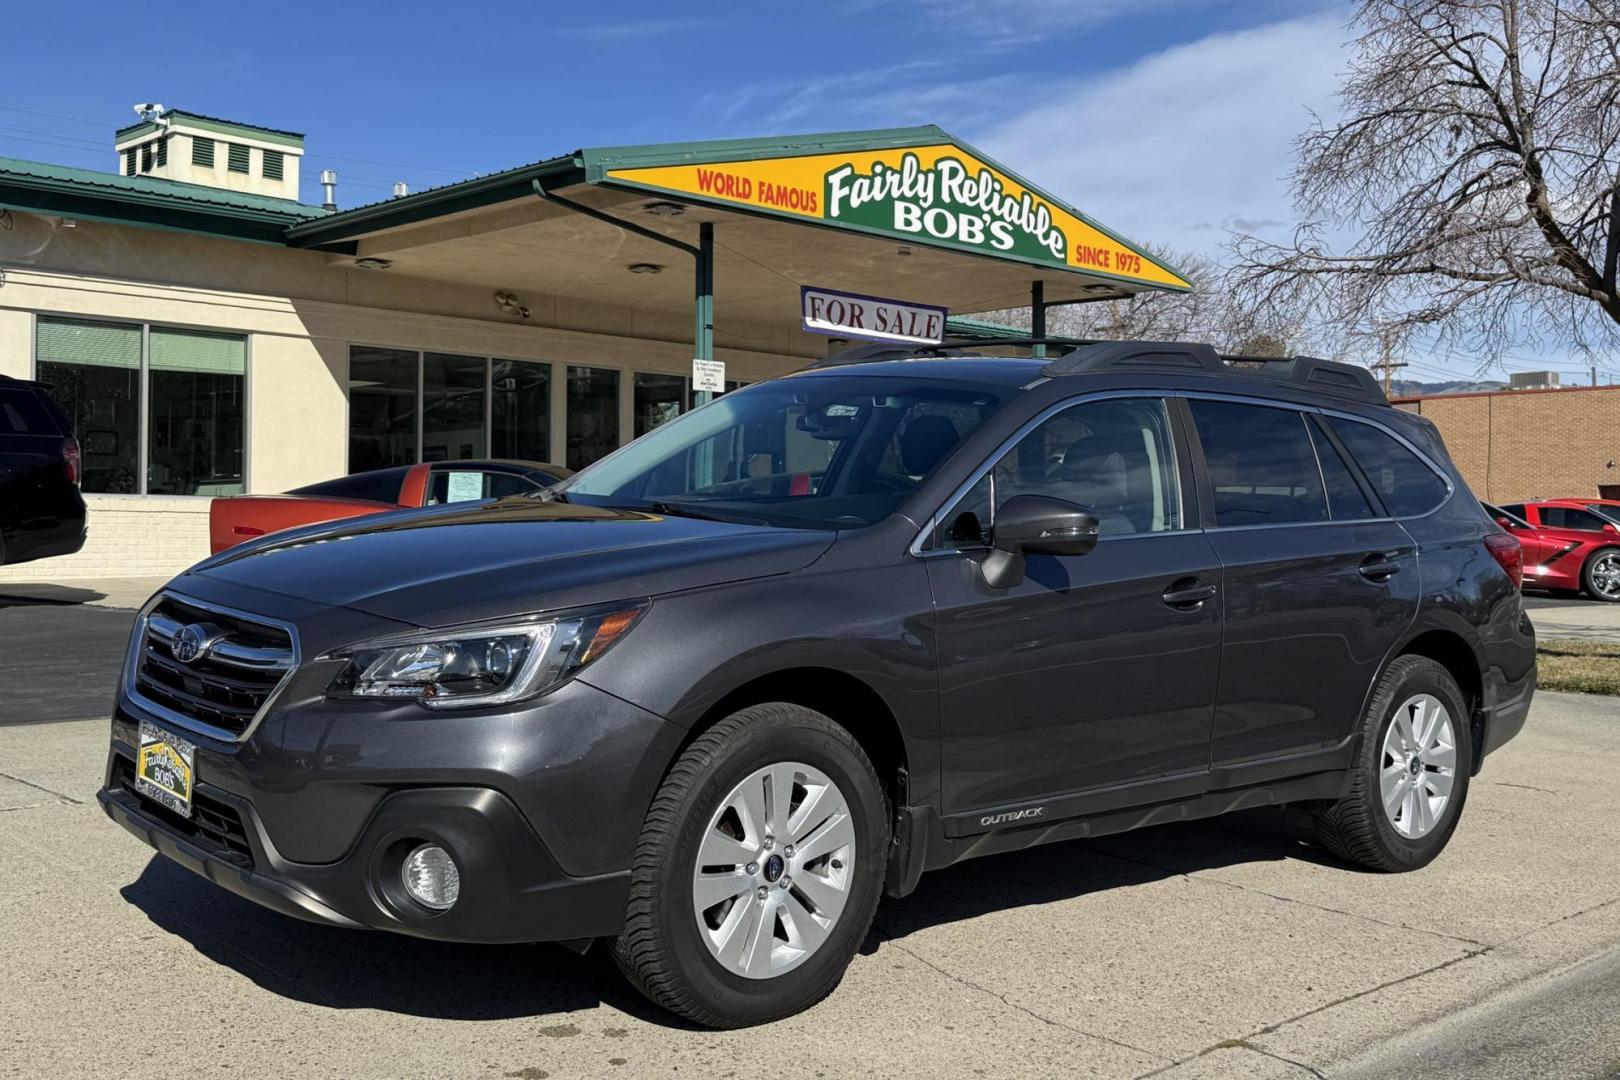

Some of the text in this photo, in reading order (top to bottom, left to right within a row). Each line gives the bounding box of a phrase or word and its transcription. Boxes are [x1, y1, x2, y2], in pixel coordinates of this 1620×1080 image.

[697, 168, 817, 213] WORLD FAMOUS
[828, 155, 1065, 259] Fairly Reliable
[894, 200, 1015, 250] BOB'S
[1076, 244, 1141, 274] SINCE 1975
[809, 296, 940, 339] FOR SALE
[981, 806, 1045, 826] OUTBACK
